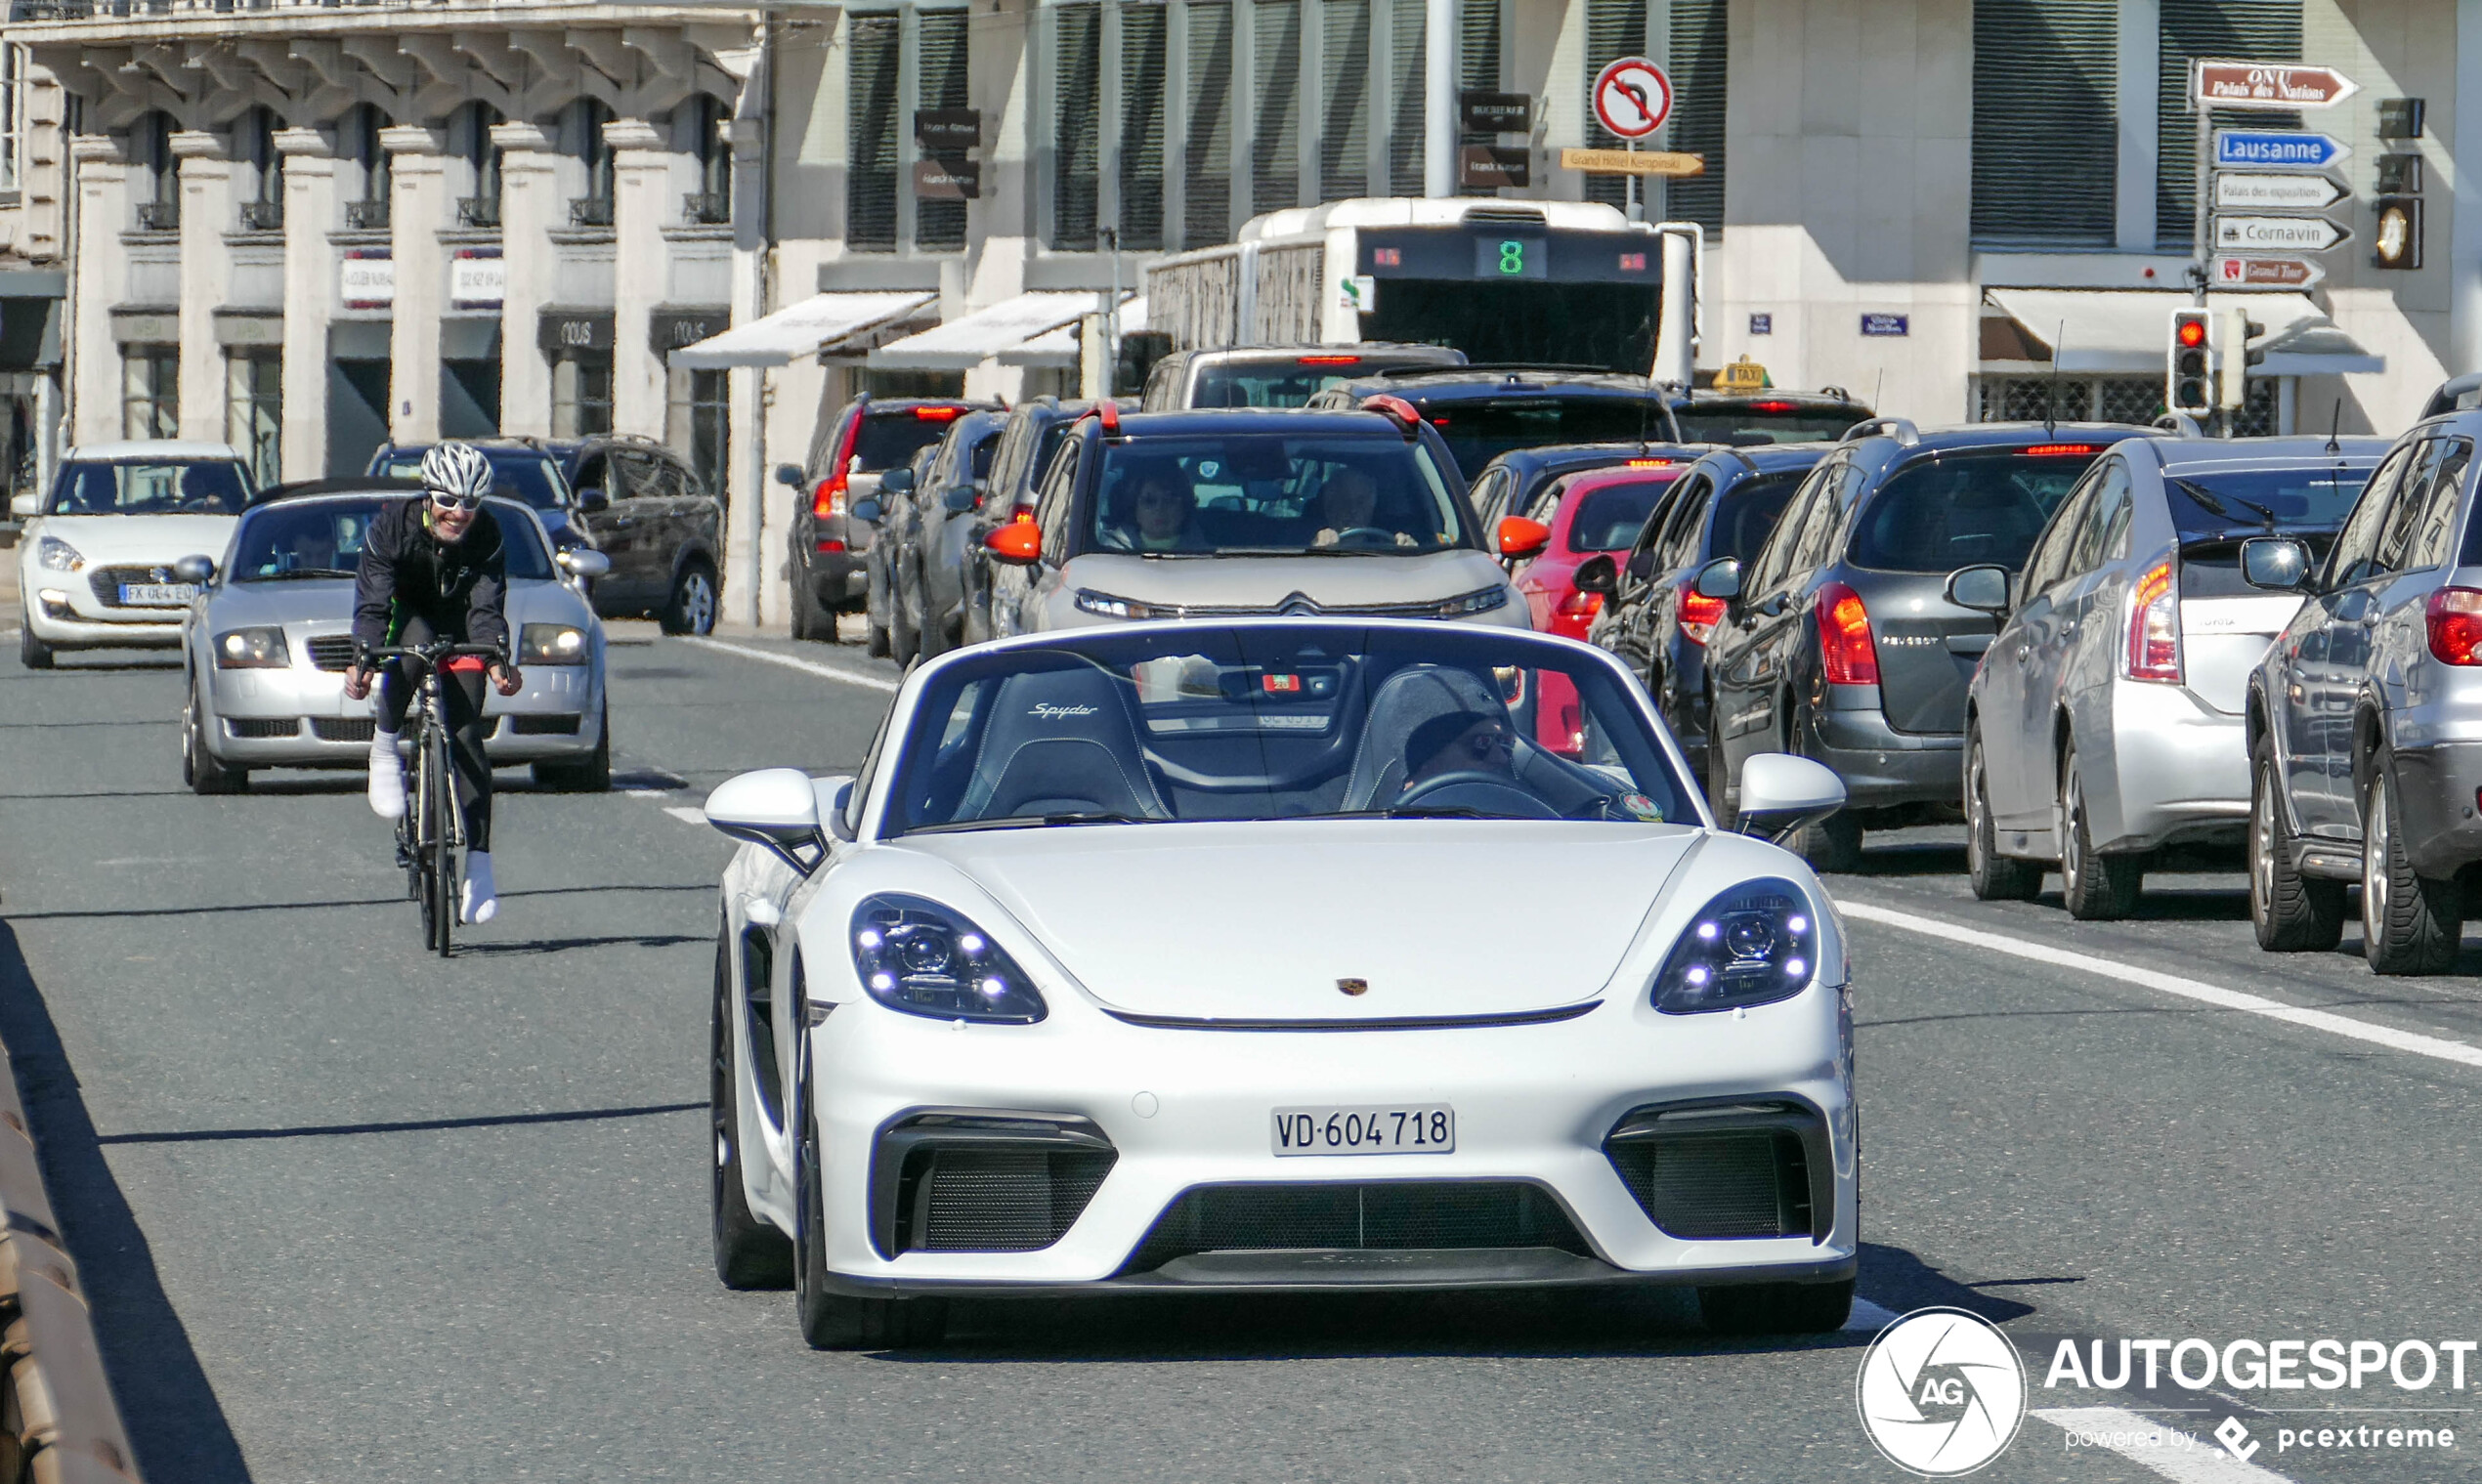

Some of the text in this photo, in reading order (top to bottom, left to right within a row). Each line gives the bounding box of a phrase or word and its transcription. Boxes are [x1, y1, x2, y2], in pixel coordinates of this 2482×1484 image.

[2247, 68, 2290, 85] ONU
[2212, 81, 2325, 101] Palais des Nations
[2222, 137, 2322, 159] Lausanne
[1569, 152, 1601, 165] Grand
[1630, 155, 1681, 171] Kempinski
[2223, 185, 2321, 200] Palais des expositions
[2247, 225, 2321, 242] Cornavin
[1499, 240, 1523, 275] 8
[128, 586, 143, 600] FK
[1882, 636, 1939, 646] PEUGEOT
[1027, 702, 1098, 720] Spyder
[1389, 1110, 1448, 1146] 718
